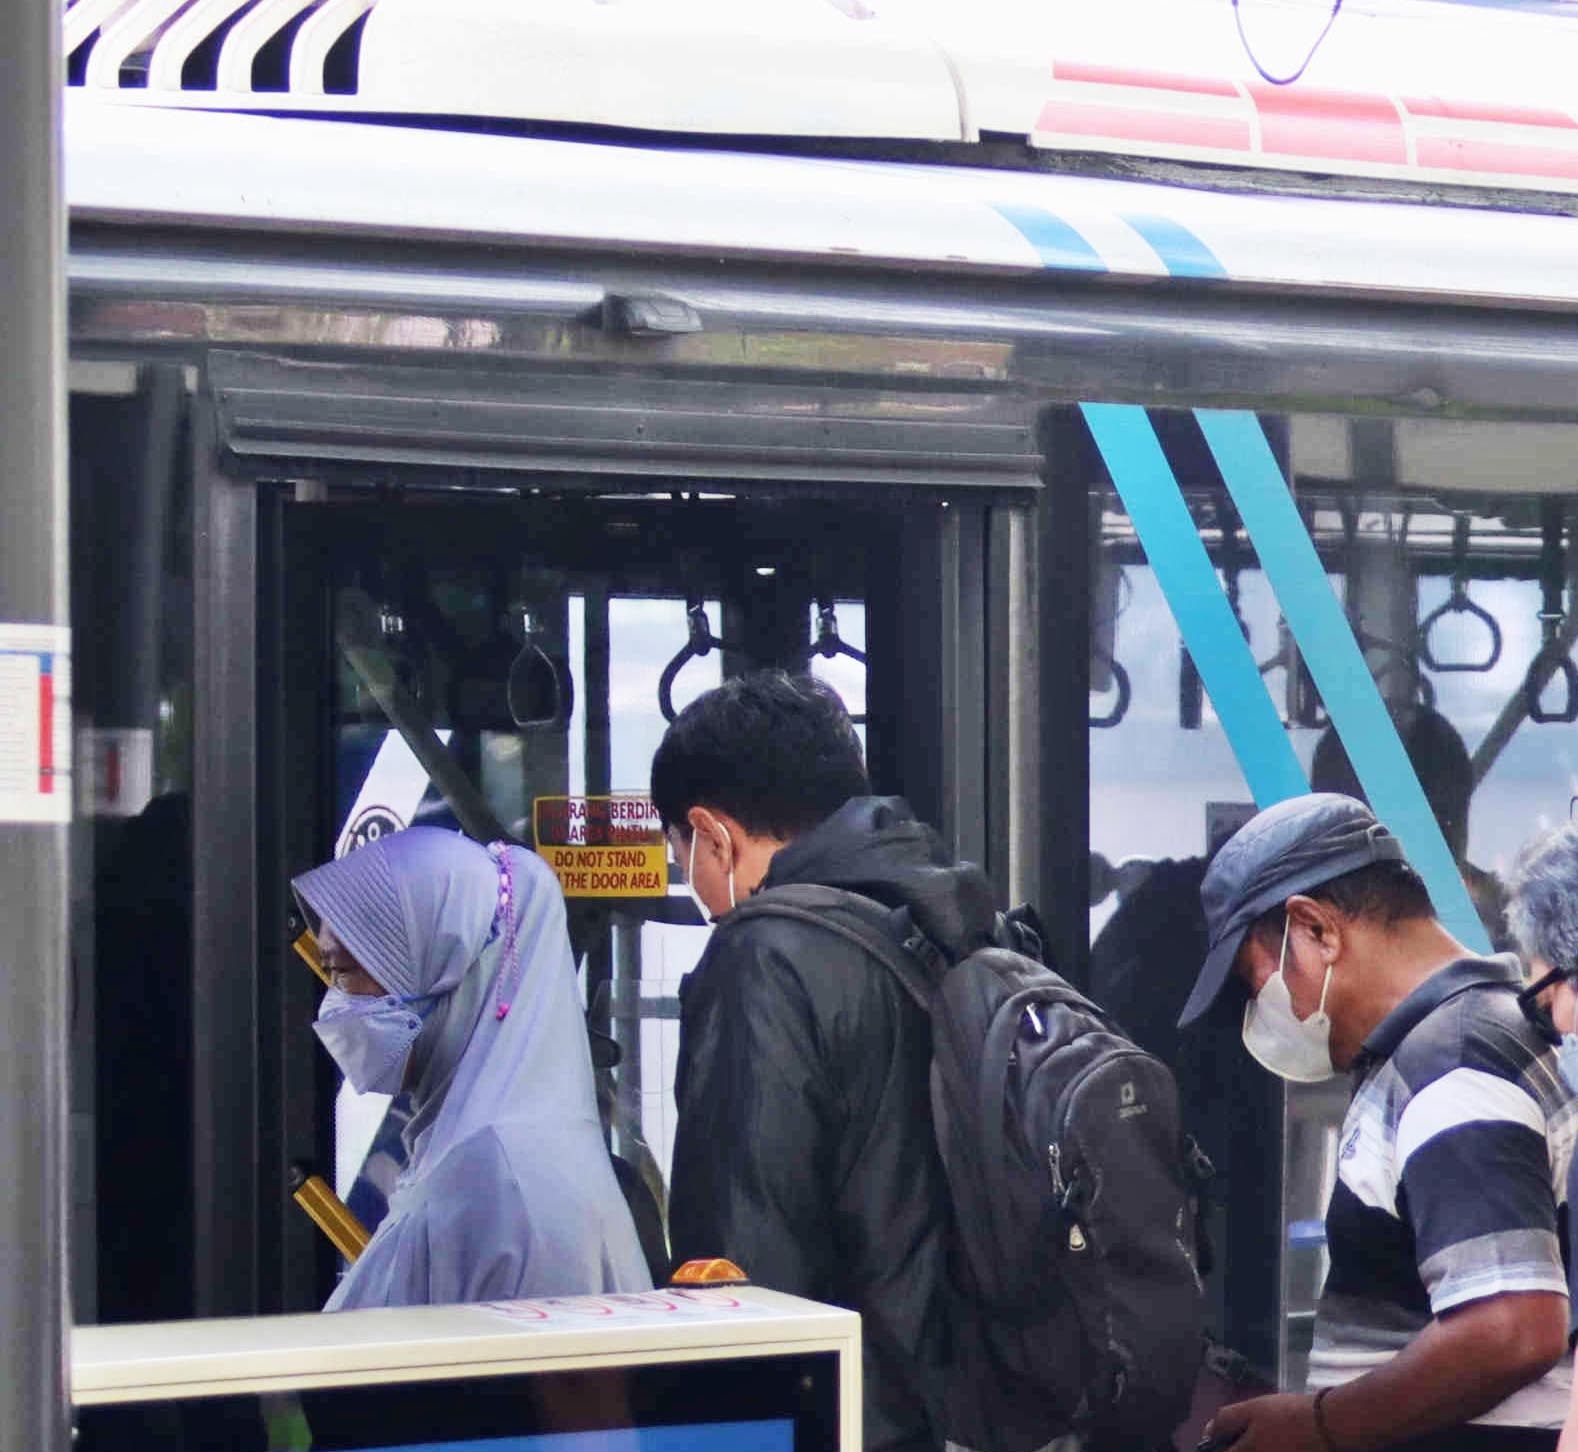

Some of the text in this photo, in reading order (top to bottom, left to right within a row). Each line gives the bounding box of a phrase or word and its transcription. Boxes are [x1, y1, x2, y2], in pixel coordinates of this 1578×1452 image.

[611, 801, 659, 820] BERDIR
[554, 850, 647, 868] DO NOT STAND
[564, 871, 662, 889] THE DOOR AREA
